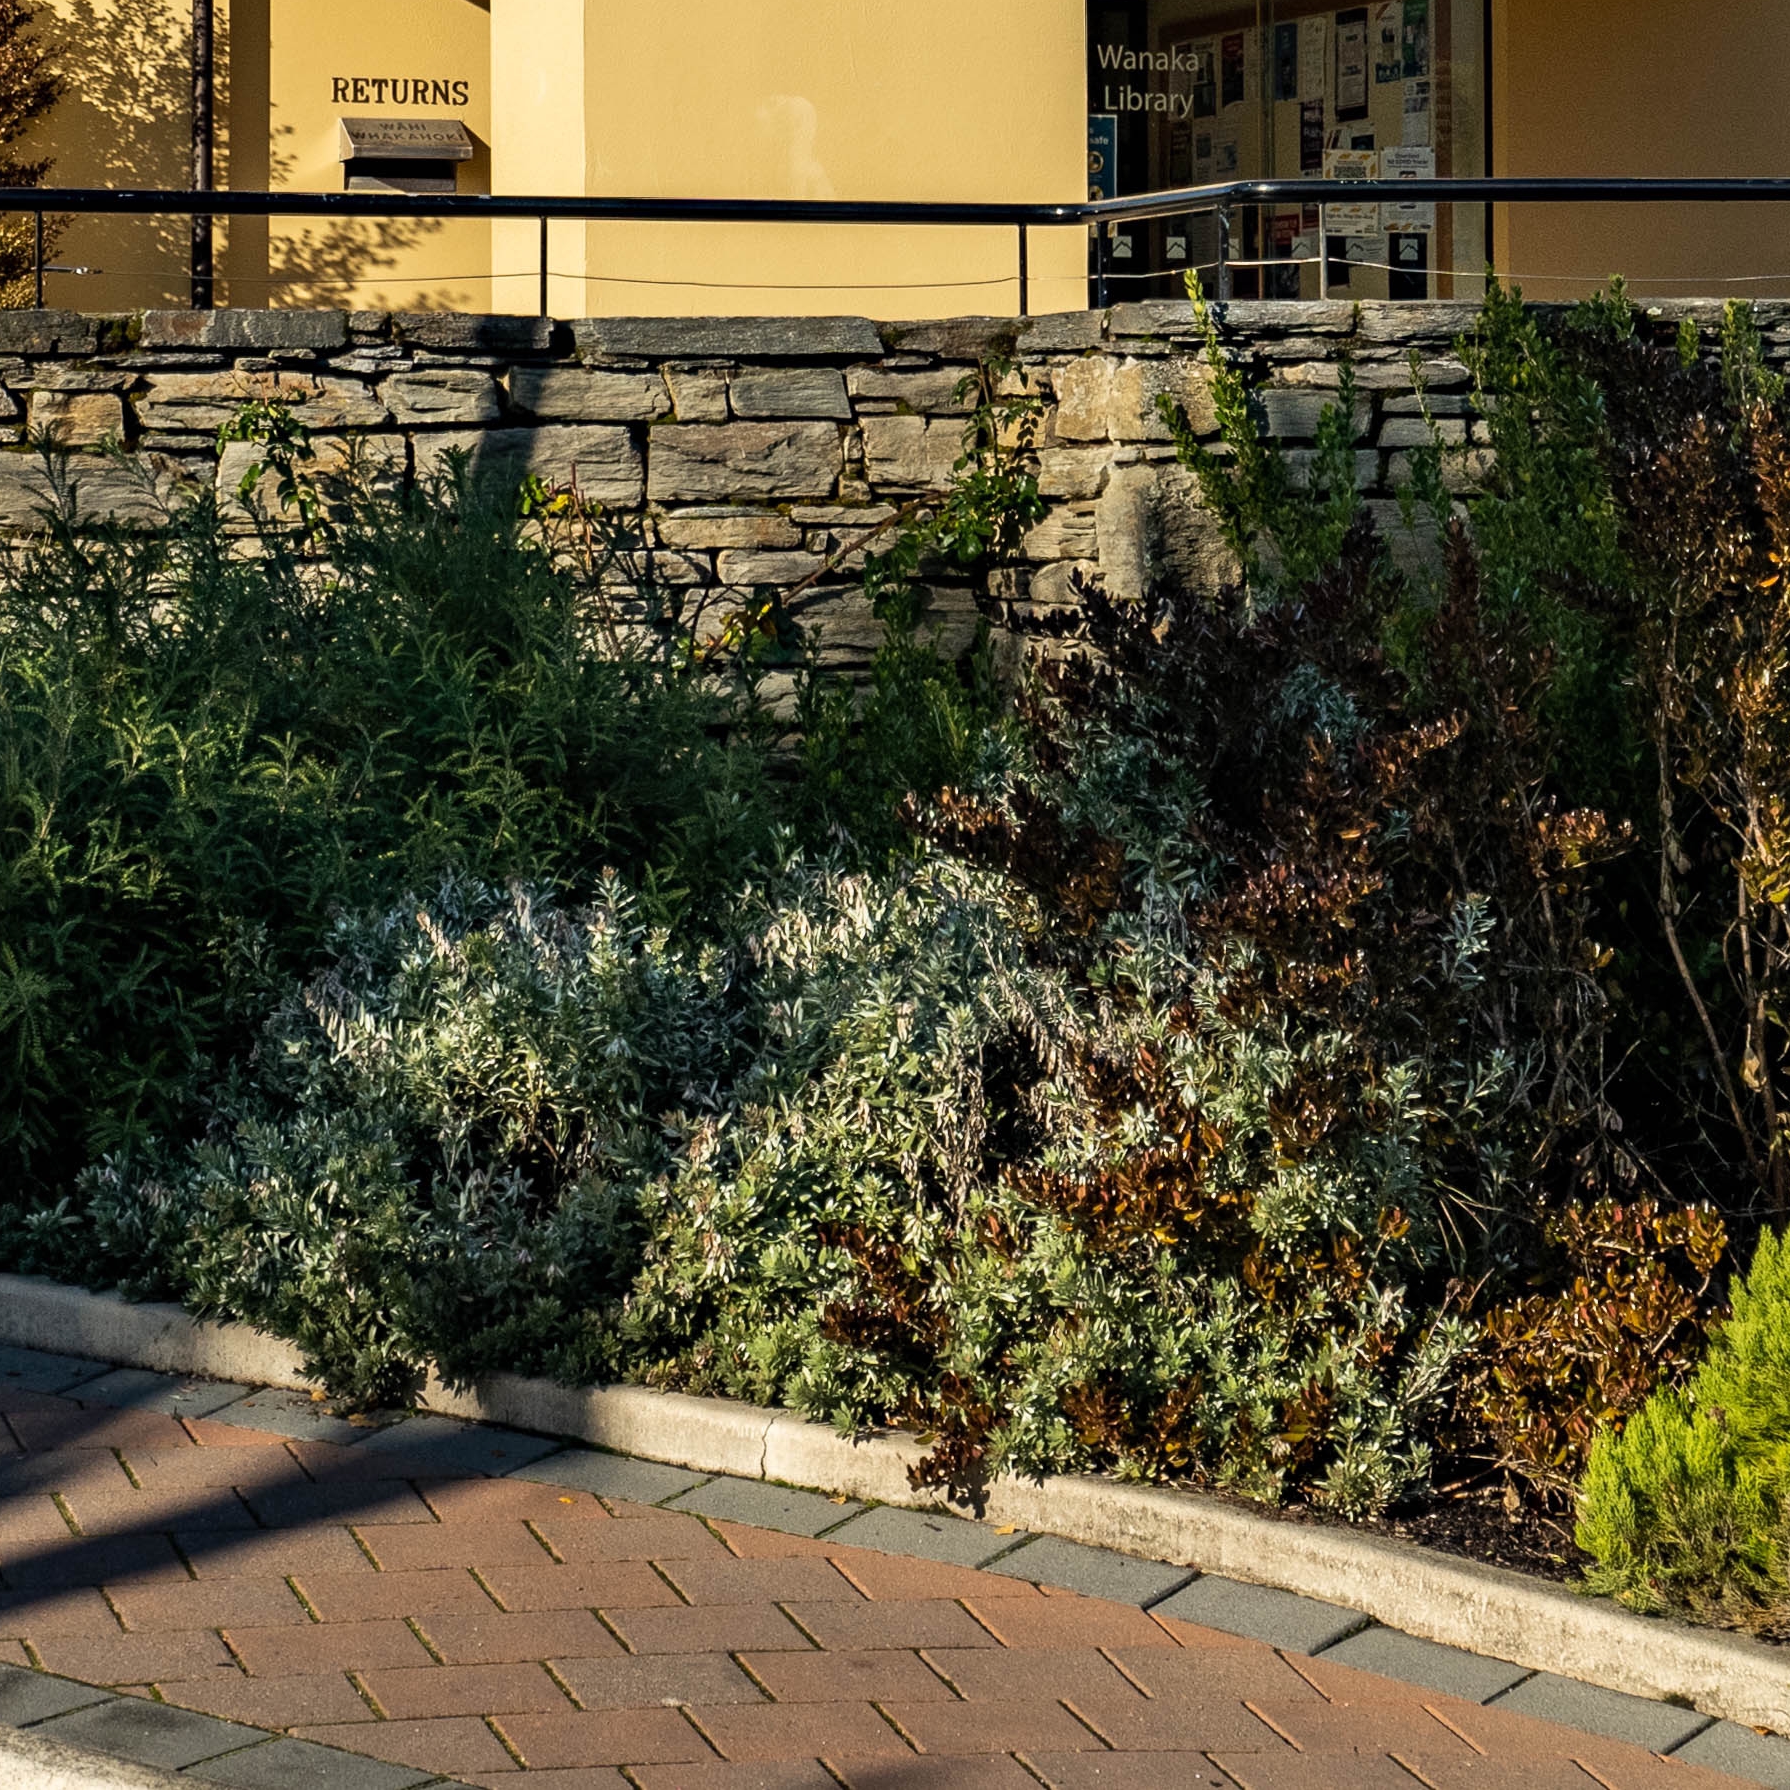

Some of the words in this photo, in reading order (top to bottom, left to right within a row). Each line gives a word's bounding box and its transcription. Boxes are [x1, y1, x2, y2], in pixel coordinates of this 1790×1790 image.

[1097, 44, 1200, 72] Wanaka
[331, 77, 469, 106] RETURNS
[1104, 84, 1195, 119] Library
